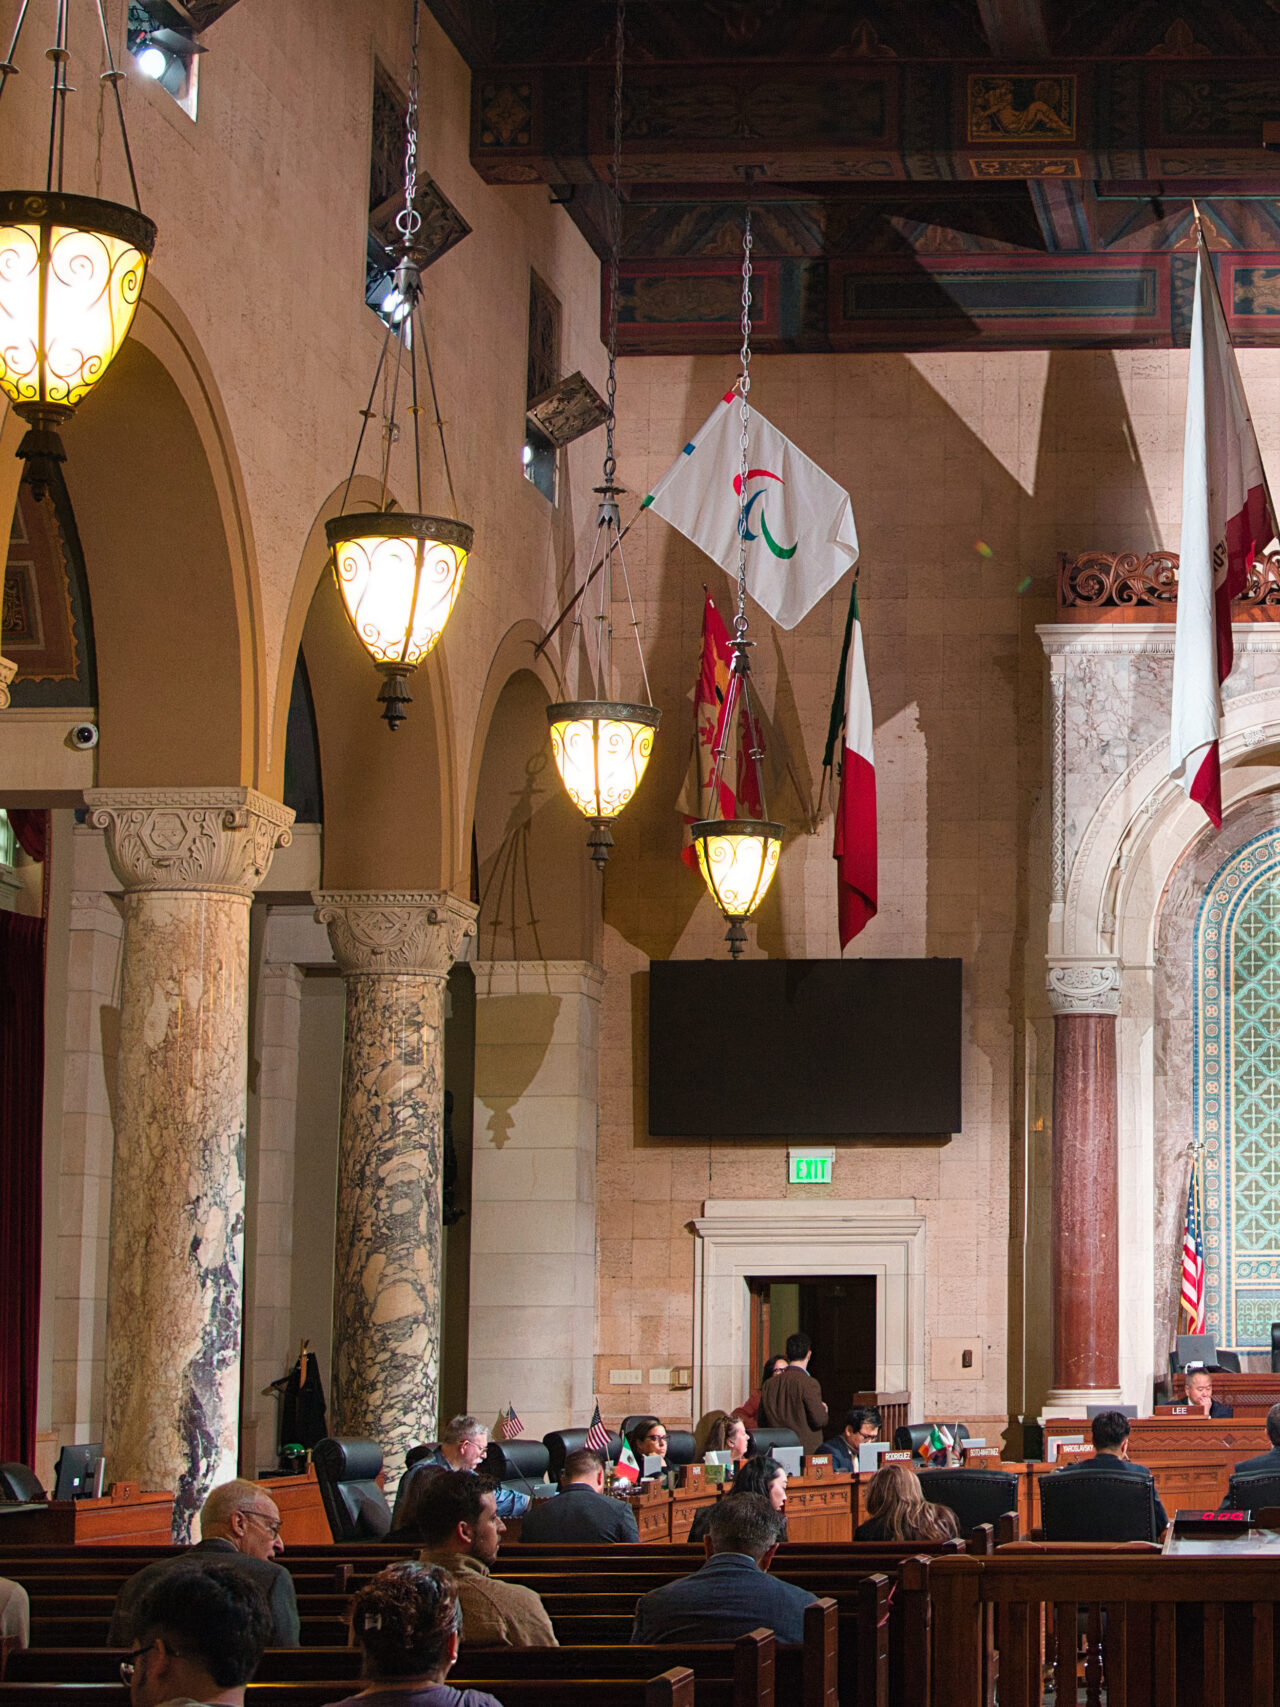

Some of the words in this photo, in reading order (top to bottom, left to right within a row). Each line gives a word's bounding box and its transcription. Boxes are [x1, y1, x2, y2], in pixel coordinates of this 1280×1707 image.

[796, 1159, 828, 1179] EXIT
[1172, 1407, 1187, 1415] LEE
[885, 1451, 911, 1461] RODRIGUEZ
